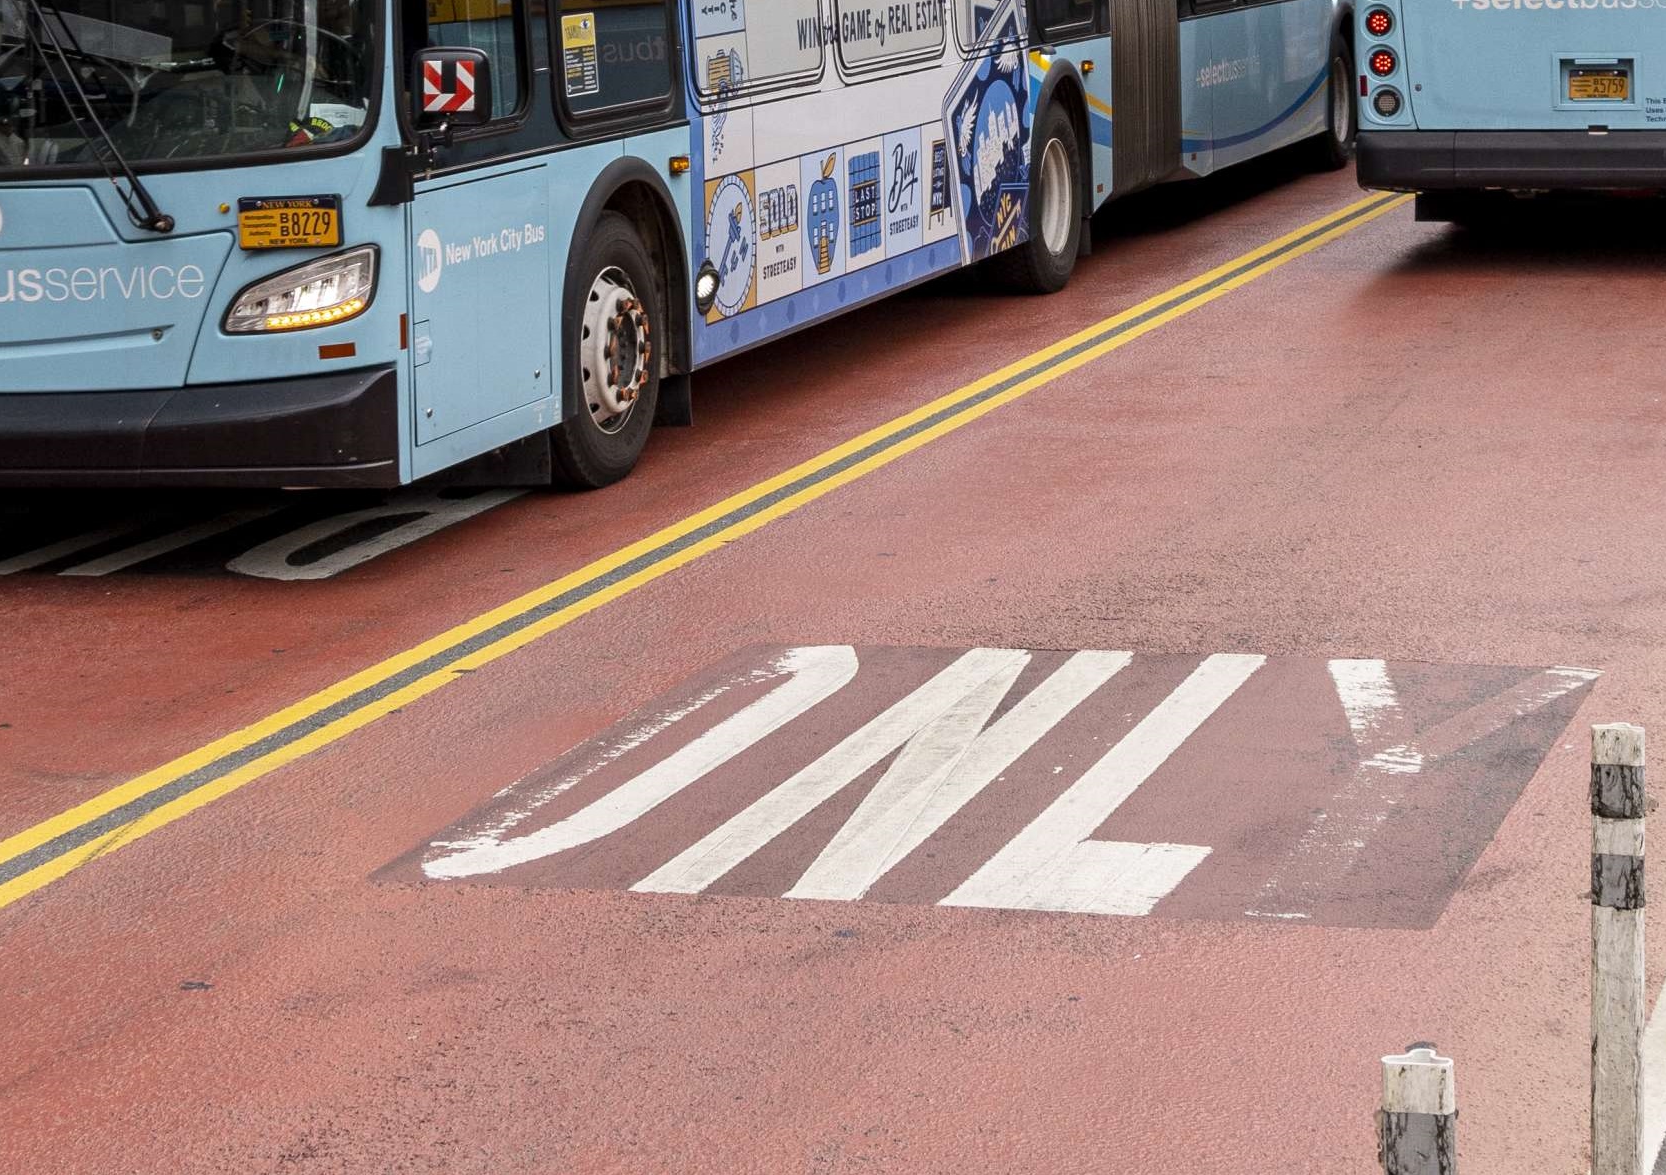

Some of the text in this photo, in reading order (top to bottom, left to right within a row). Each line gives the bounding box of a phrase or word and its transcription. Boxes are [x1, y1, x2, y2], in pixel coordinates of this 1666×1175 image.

[796, 14, 822, 51] WIN
[842, 8, 872, 43] GAME
[888, 2, 913, 36] REAL
[1645, 97, 1662, 105] This
[1645, 106, 1664, 114] Uses
[888, 143, 918, 214] Buy
[262, 200, 313, 209] NEW YORK
[854, 186, 877, 203] LAST
[758, 183, 799, 241] SOLD
[854, 202, 877, 224] STOP
[889, 215, 919, 237] STREETEASY
[445, 223, 545, 266] New York City Bus
[762, 256, 797, 281] STREETEASY
[419, 642, 1604, 922] ONLY
